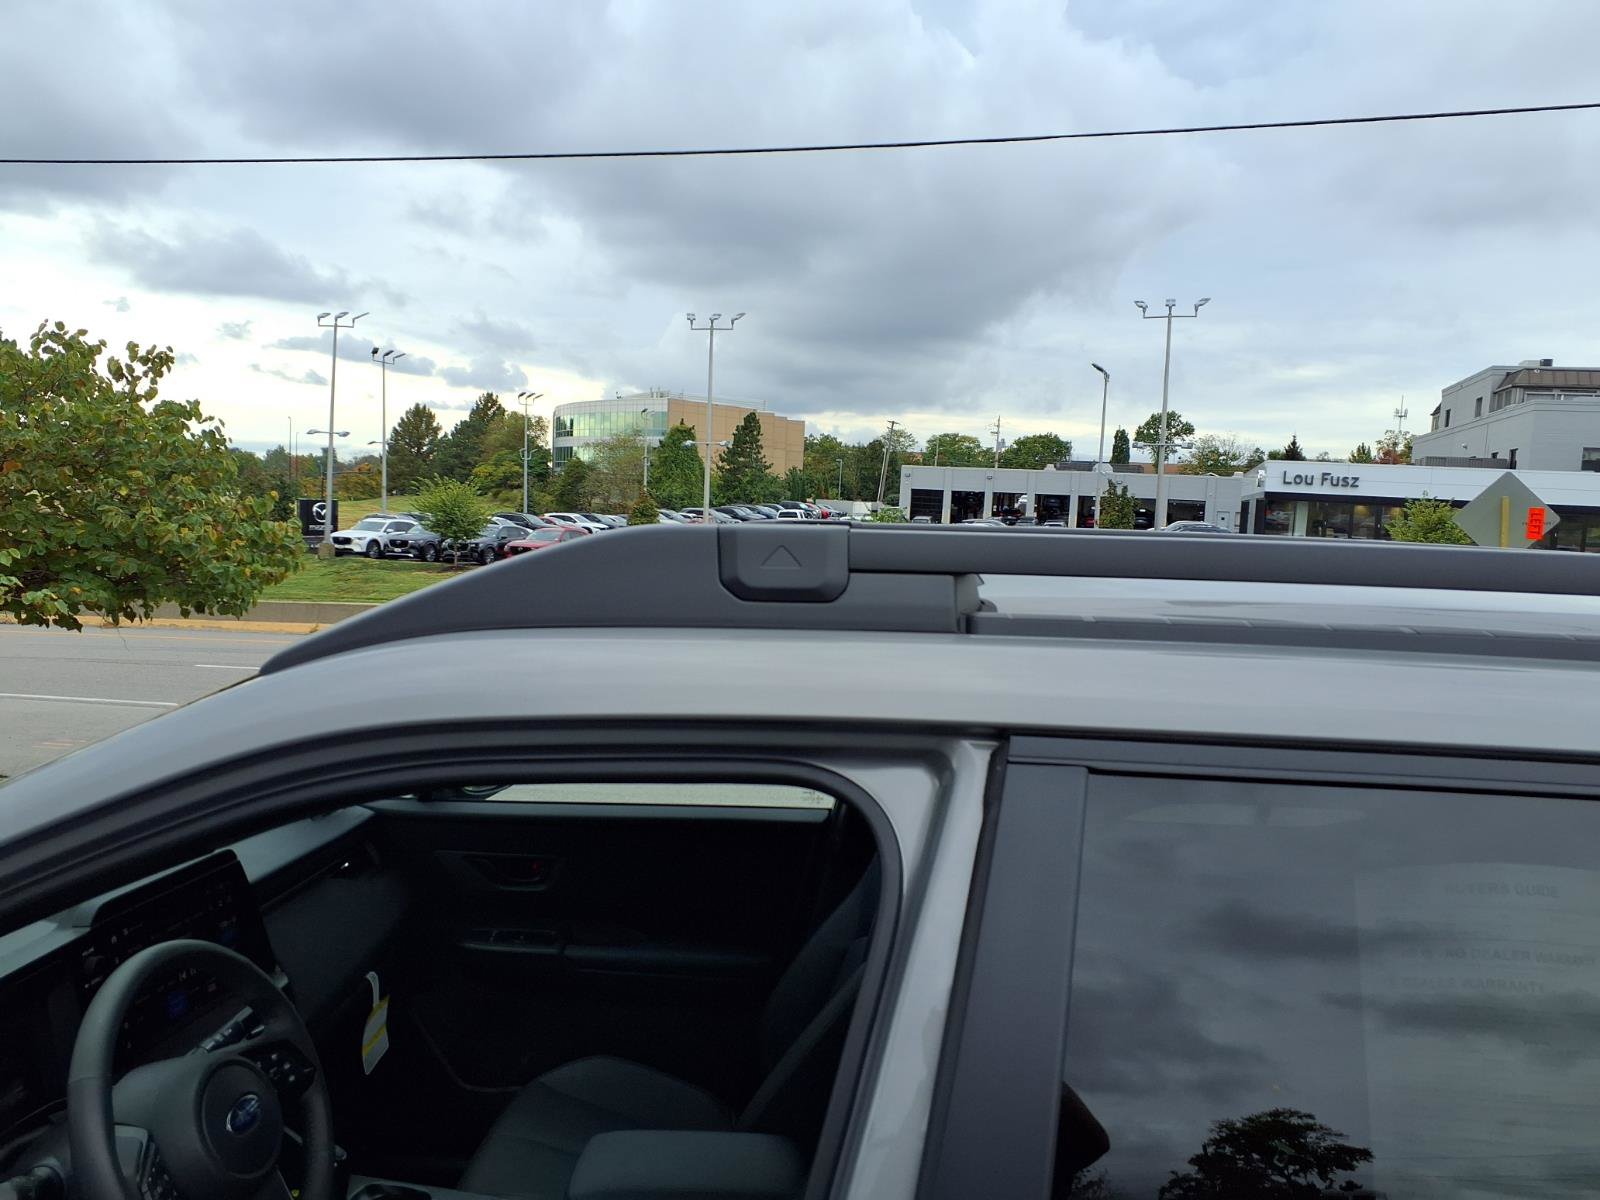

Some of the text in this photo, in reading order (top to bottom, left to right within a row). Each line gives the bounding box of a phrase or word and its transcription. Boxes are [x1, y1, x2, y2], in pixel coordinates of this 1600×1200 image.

[1282, 470, 1360, 488] Lou Fusz
[1529, 512, 1544, 536] LEFT
